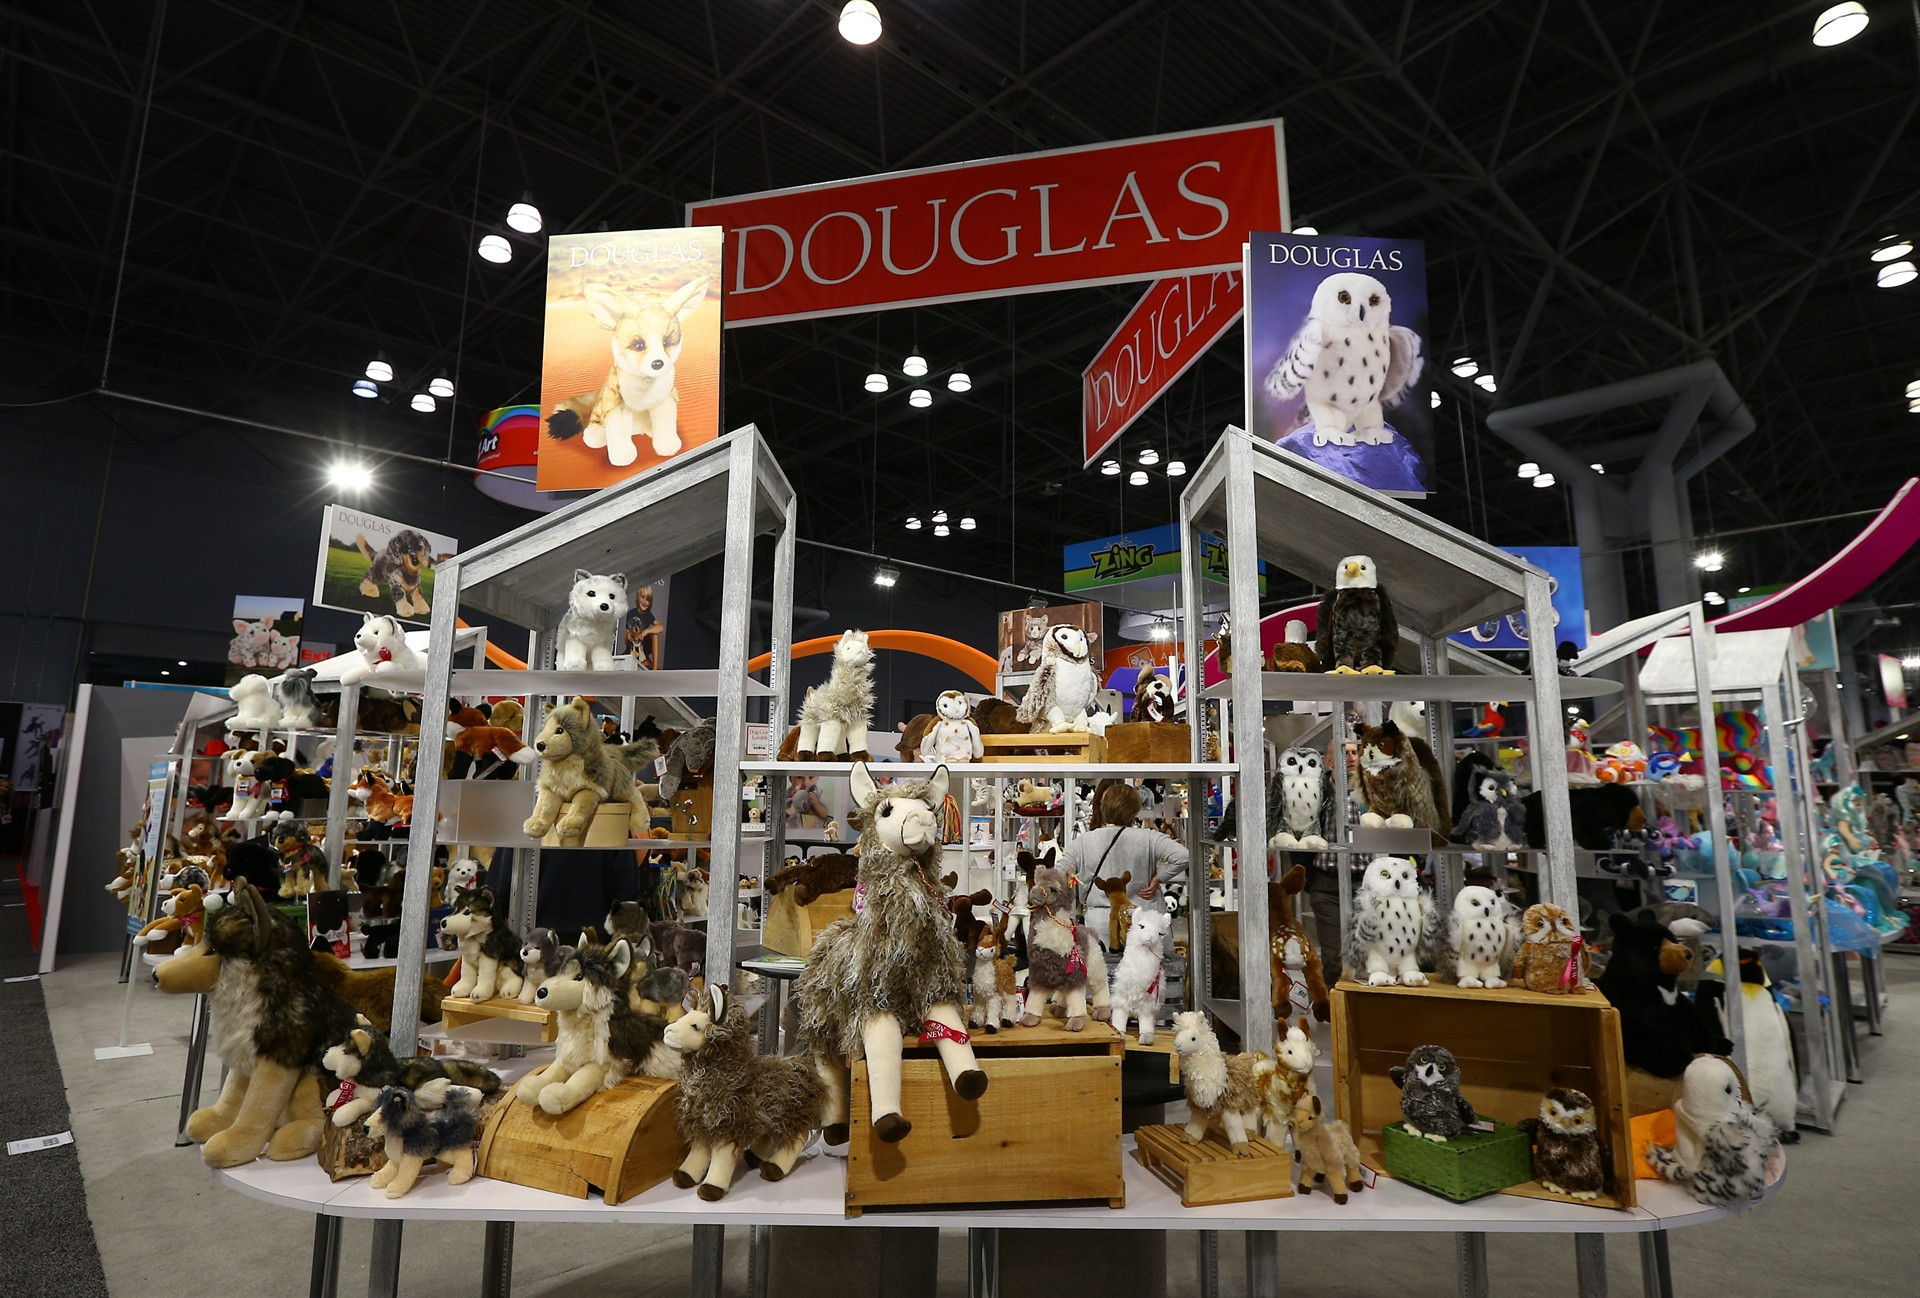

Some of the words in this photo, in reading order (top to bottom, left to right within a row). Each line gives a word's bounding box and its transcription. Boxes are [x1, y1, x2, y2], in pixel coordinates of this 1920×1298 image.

[729, 161, 1231, 296] DOUGLAS
[569, 239, 702, 268] DOUGLAS
[1269, 243, 1404, 271] DOUGLAS
[1091, 271, 1239, 433] DOUGLA
[338, 511, 392, 535] DOUGLAS
[926, 1031, 944, 1039] NEW
